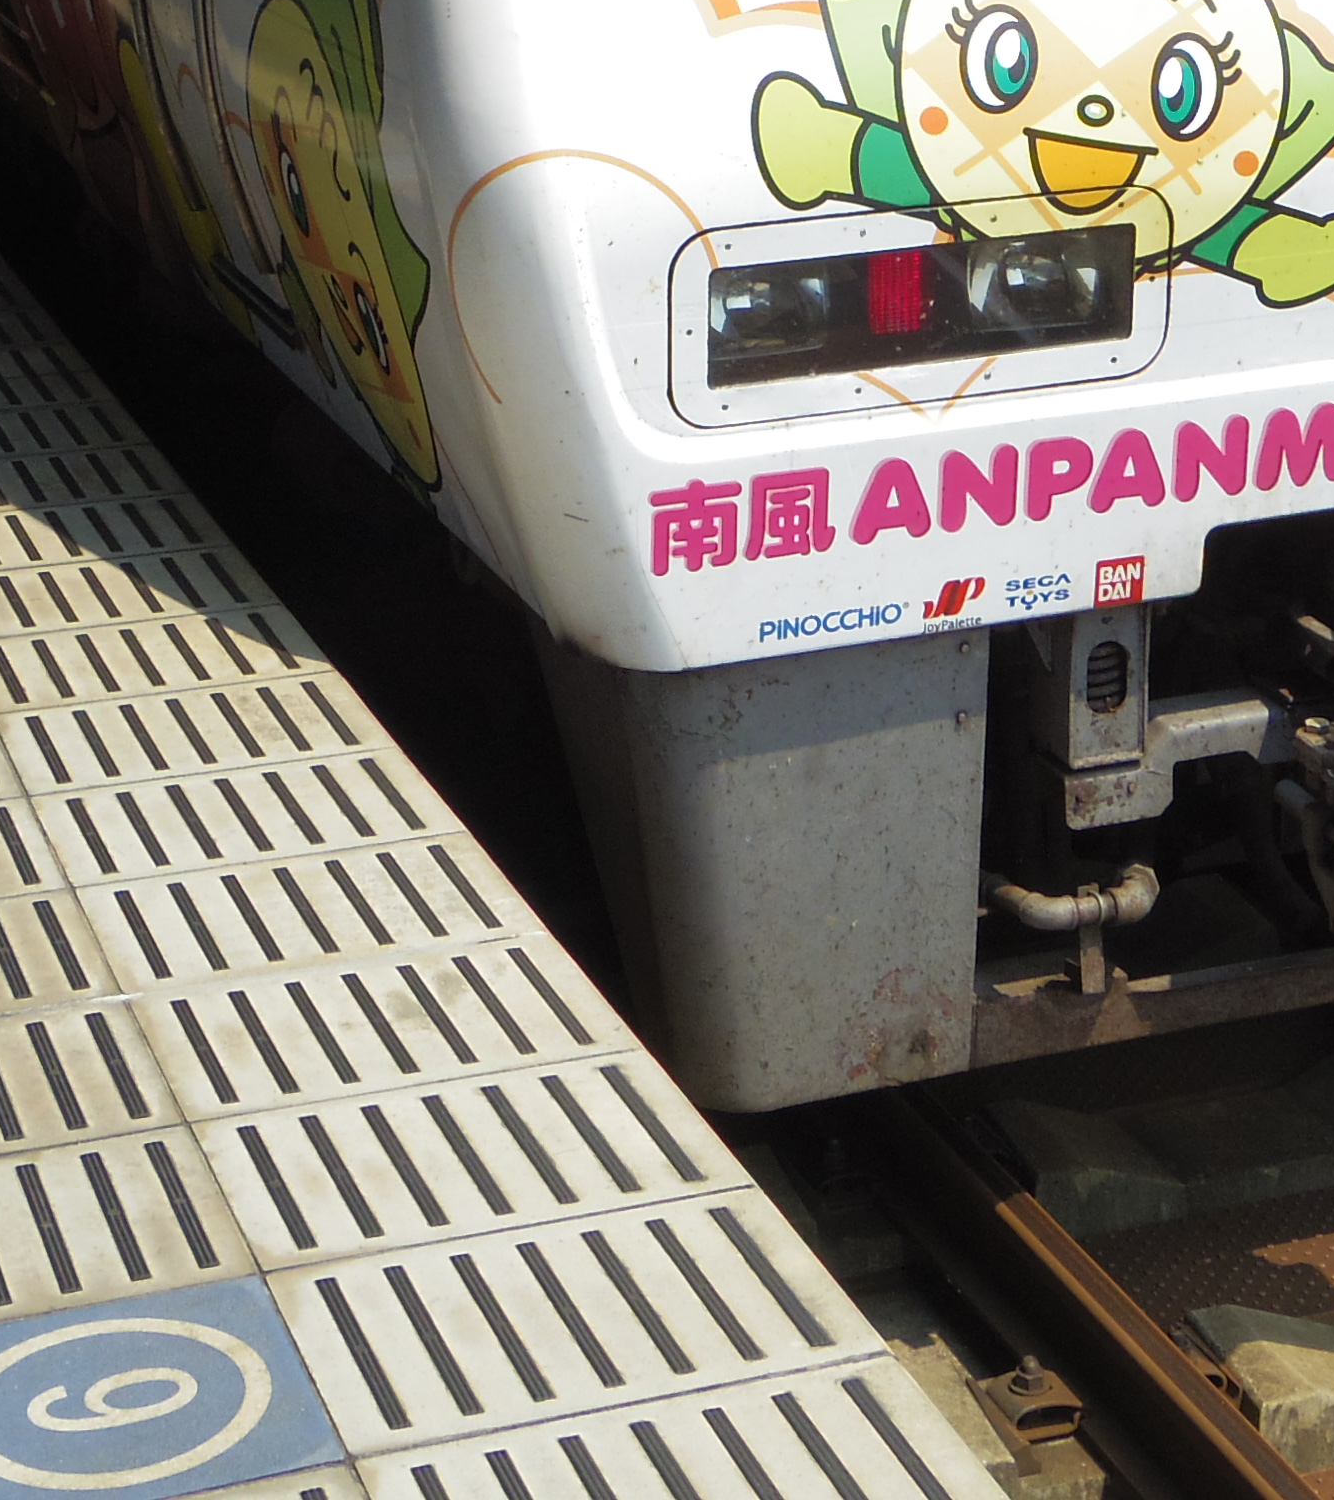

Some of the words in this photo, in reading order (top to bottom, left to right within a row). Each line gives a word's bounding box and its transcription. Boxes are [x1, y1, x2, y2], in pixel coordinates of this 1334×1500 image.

[649, 466, 836, 577] 南風
[1005, 573, 1072, 592] SEGA
[1099, 561, 1141, 585] BAN
[1005, 589, 1071, 610] TOYS
[1098, 580, 1132, 602] DAI
[759, 603, 903, 643] PINOCCHIO
[923, 615, 983, 634] JoyPalette
